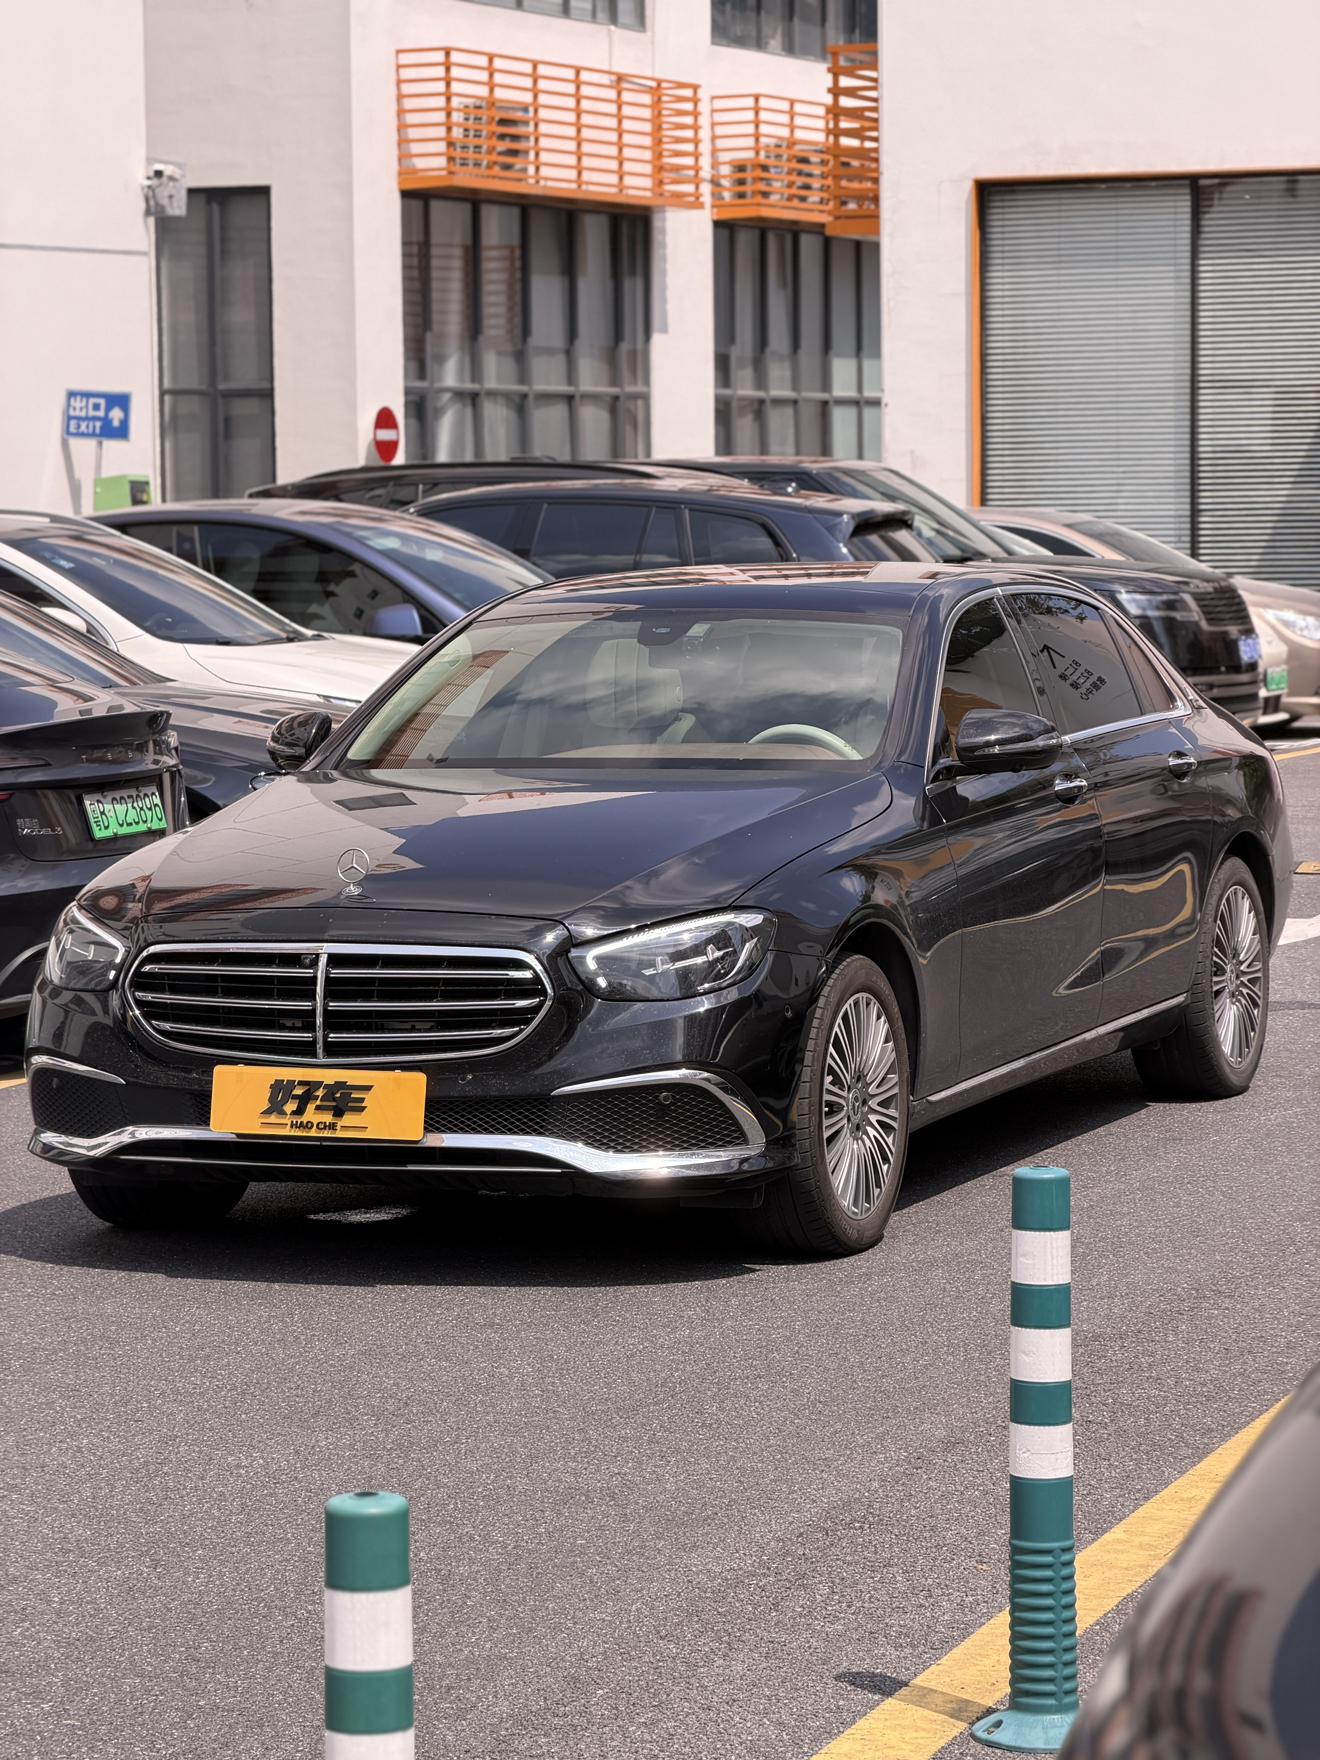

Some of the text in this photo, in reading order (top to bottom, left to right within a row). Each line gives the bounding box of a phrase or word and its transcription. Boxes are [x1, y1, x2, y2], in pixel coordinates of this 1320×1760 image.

[69, 395, 105, 417] 出口
[69, 419, 102, 434] EXIT
[259, 1079, 375, 1118] 好车
[290, 1120, 338, 1131] HAO CHE
